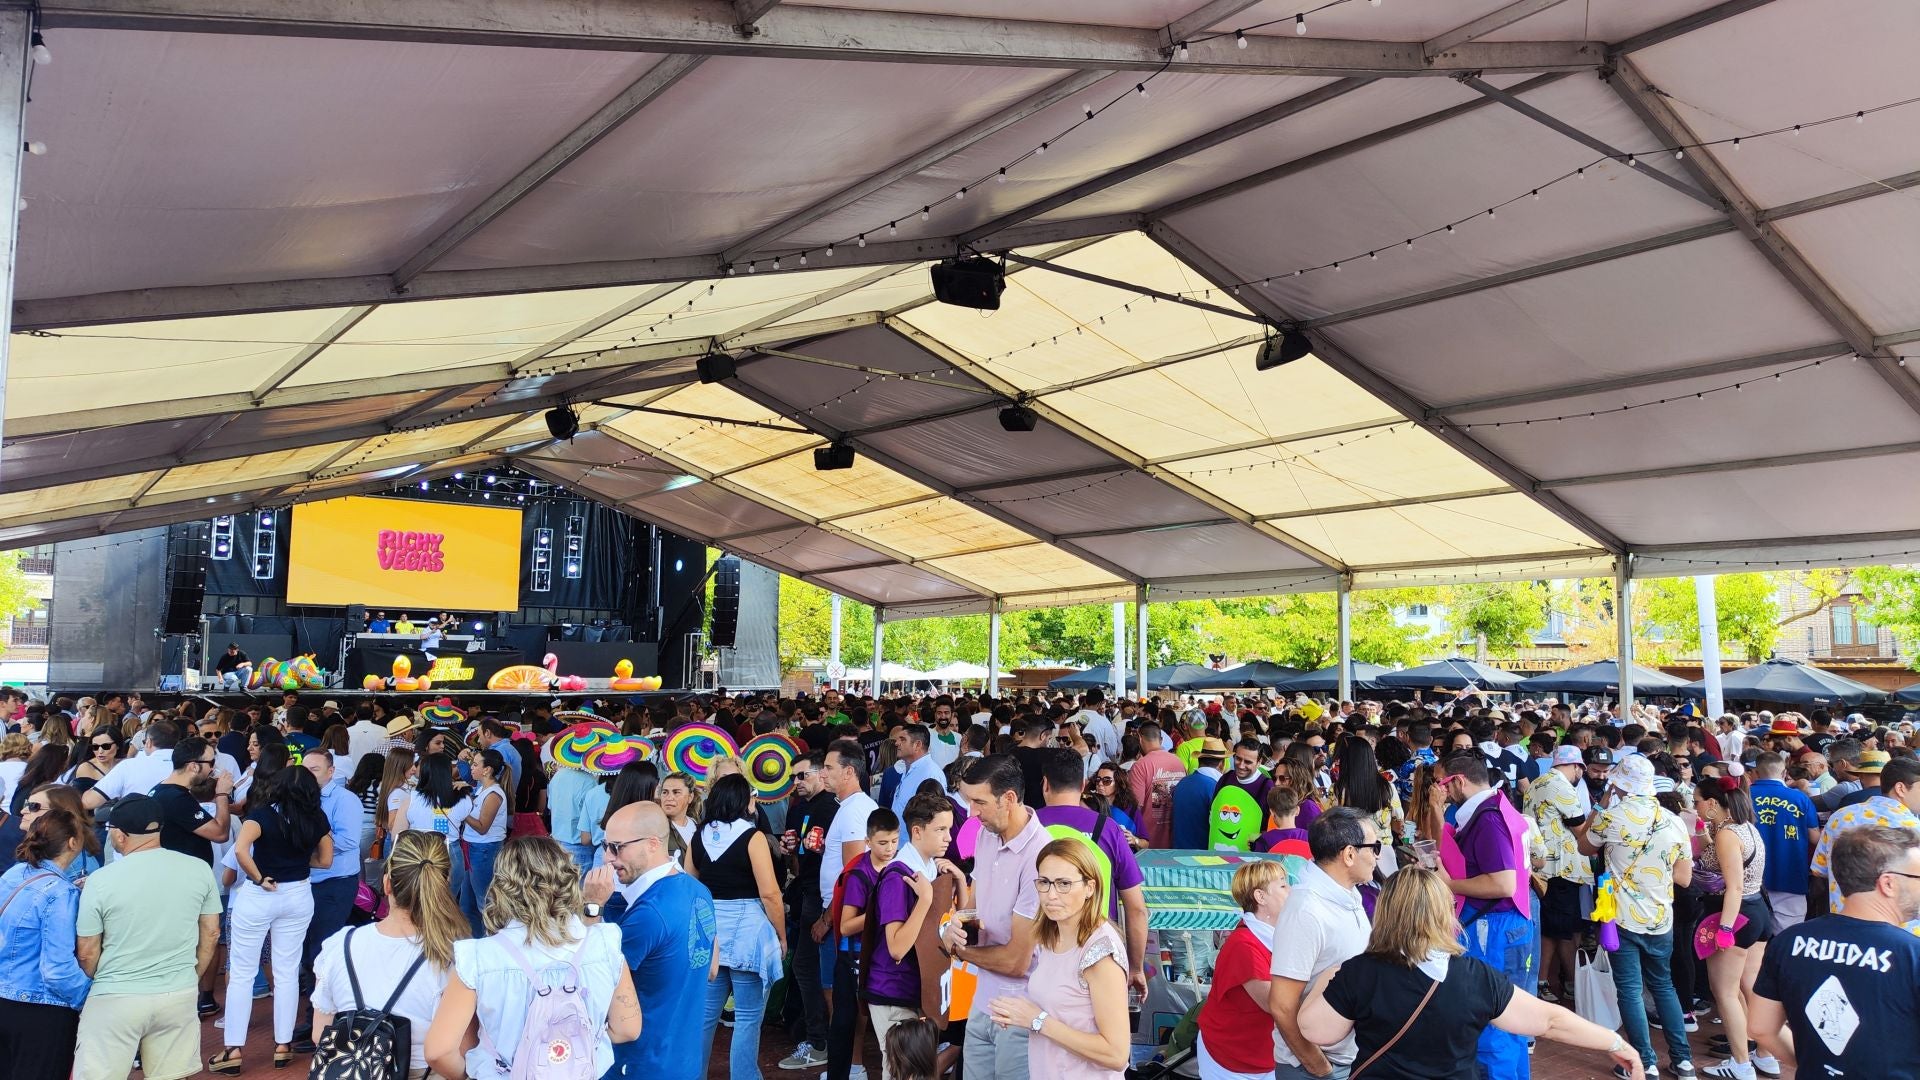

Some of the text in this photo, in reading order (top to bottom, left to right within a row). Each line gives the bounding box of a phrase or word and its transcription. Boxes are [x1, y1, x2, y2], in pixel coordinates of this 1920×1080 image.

[378, 530, 444, 551] RICHY
[377, 549, 445, 572] VEGAS
[1755, 796, 1805, 818] SARAOS
[1791, 935, 1893, 973] DRUIDAS
